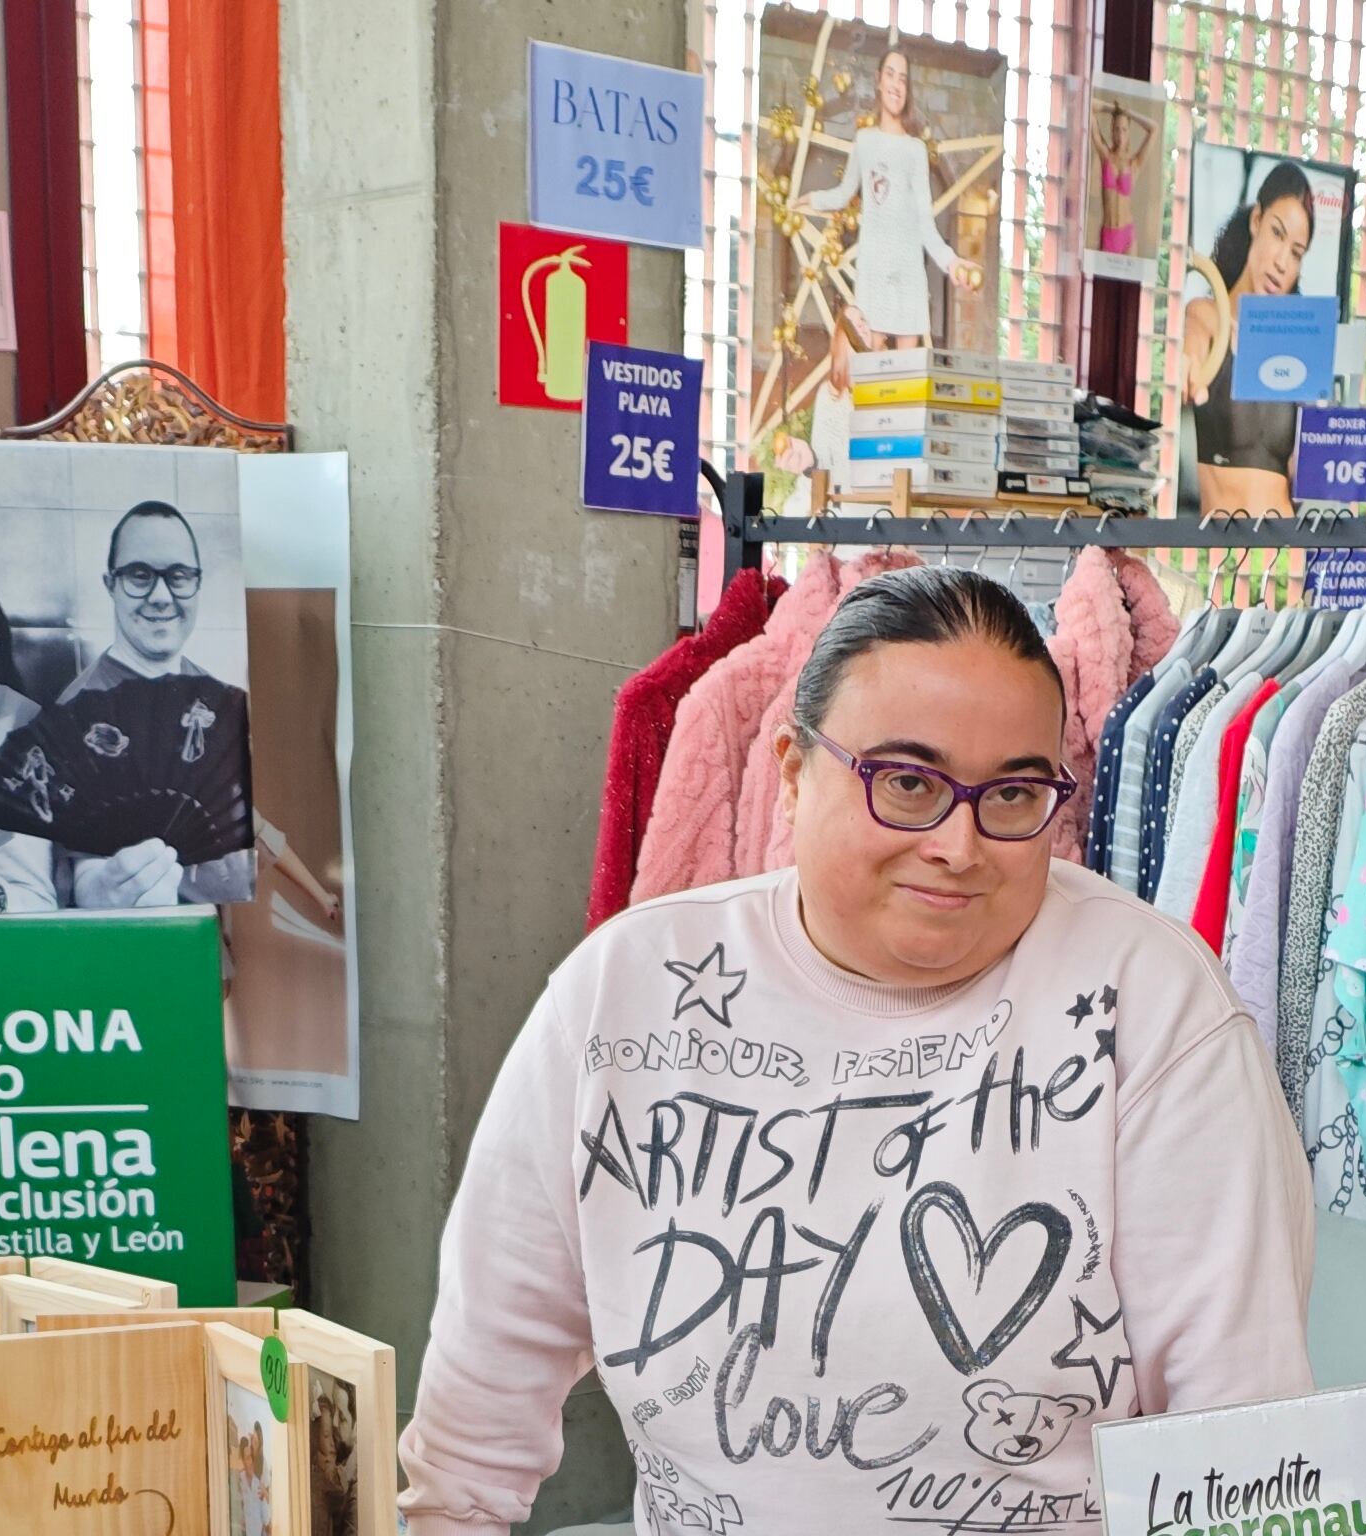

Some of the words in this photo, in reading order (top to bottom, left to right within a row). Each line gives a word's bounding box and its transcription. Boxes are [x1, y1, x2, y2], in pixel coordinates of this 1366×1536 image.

[551, 77, 679, 146] BATAS
[576, 153, 655, 207] 25€
[602, 360, 684, 390] VESTIDOS
[619, 391, 673, 420] PLAYA
[1328, 417, 1366, 431] BOXER
[609, 435, 674, 484] 25€
[1301, 431, 1342, 446] TOMMY
[835, 1000, 1012, 1085] FRIEND
[580, 1090, 934, 1217] ARTIST
[873, 1097, 955, 1190] of
[84, 1234, 101, 1260] y
[111, 1223, 184, 1252] León
[603, 1195, 885, 1376] DAY
[715, 1323, 939, 1470] love
[79, 1420, 102, 1448] al
[106, 1414, 141, 1452] fin
[146, 1409, 181, 1442] del
[53, 1473, 129, 1511] Mundo
[876, 1468, 1011, 1536] 100%
[1147, 1472, 1195, 1536] La
[1204, 1452, 1322, 1522] tiendita
